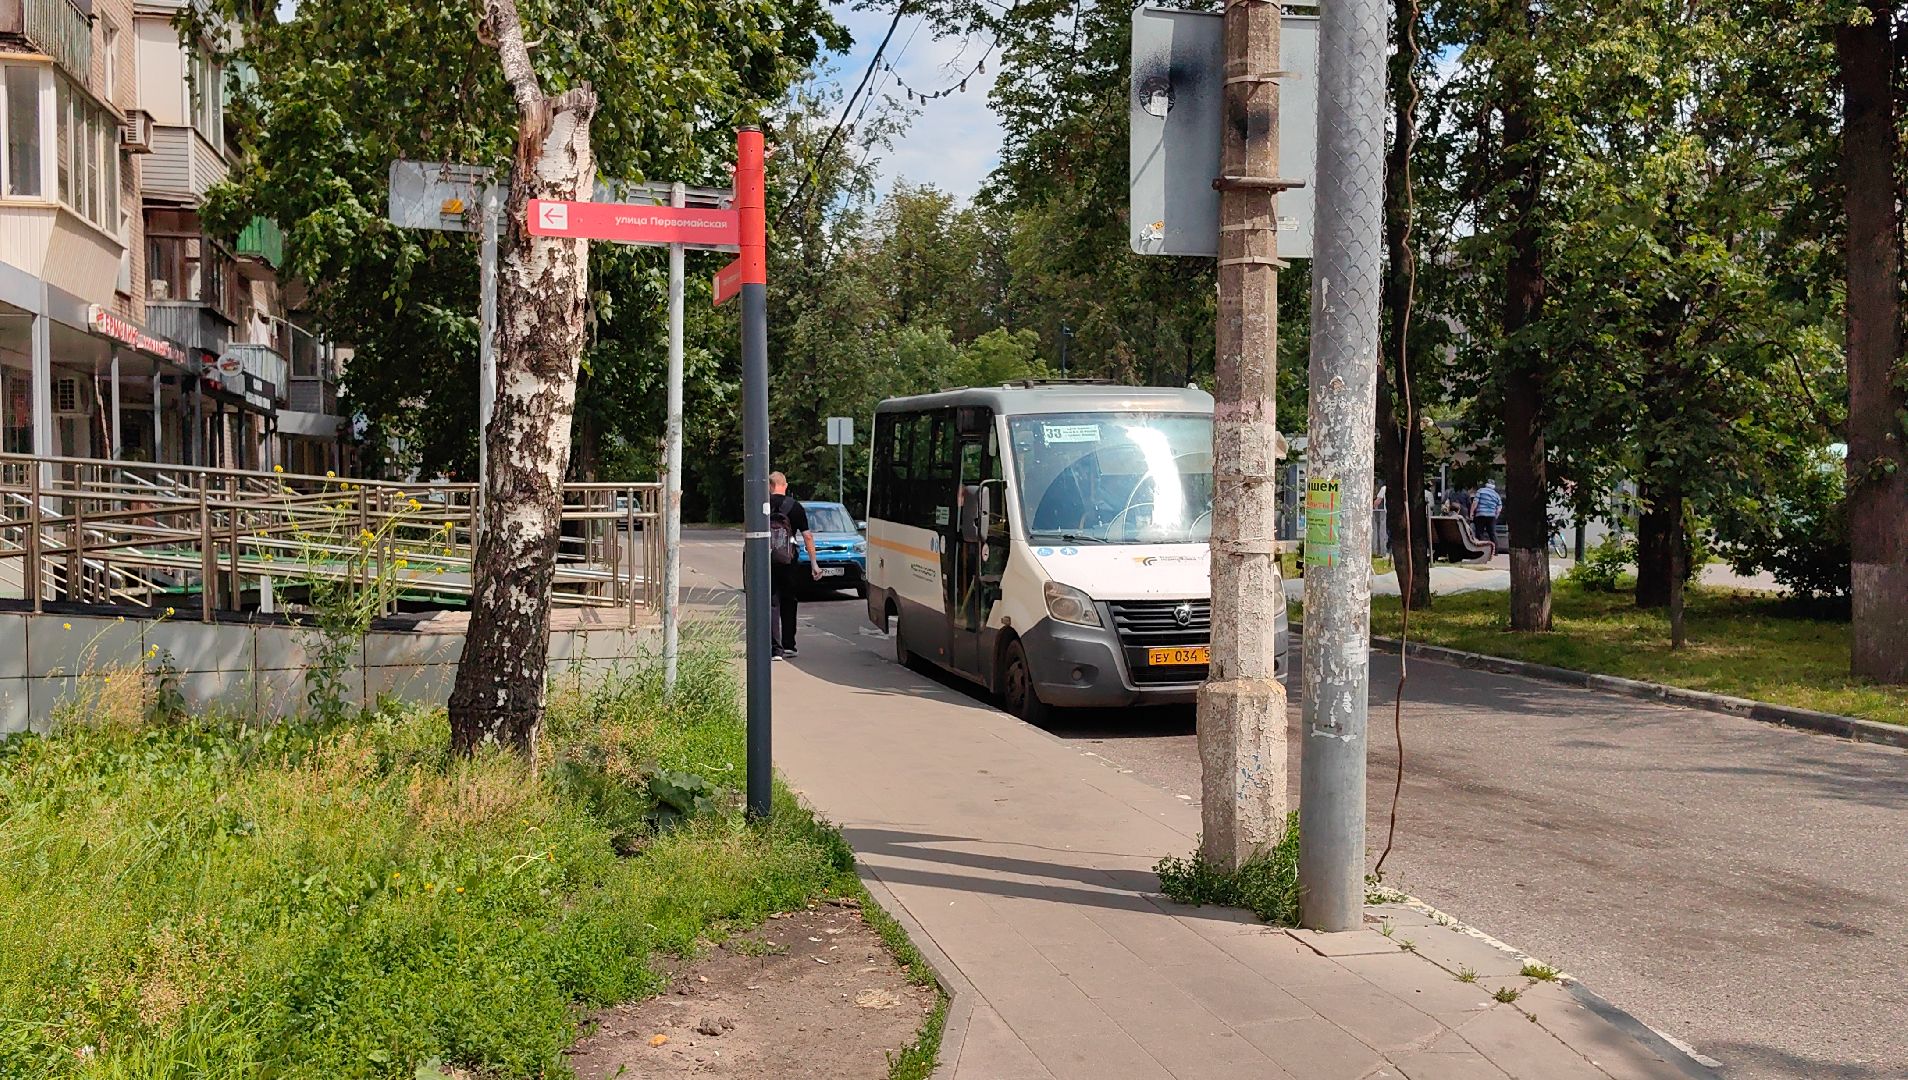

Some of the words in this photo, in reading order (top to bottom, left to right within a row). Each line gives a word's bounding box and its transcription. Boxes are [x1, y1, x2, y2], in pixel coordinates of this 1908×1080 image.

[615, 216, 648, 226] улица
[650, 216, 728, 228] Первомайская
[1045, 428, 1061, 438] 33
[1155, 653, 1169, 663] ЕУ
[1175, 650, 1197, 662] 034
